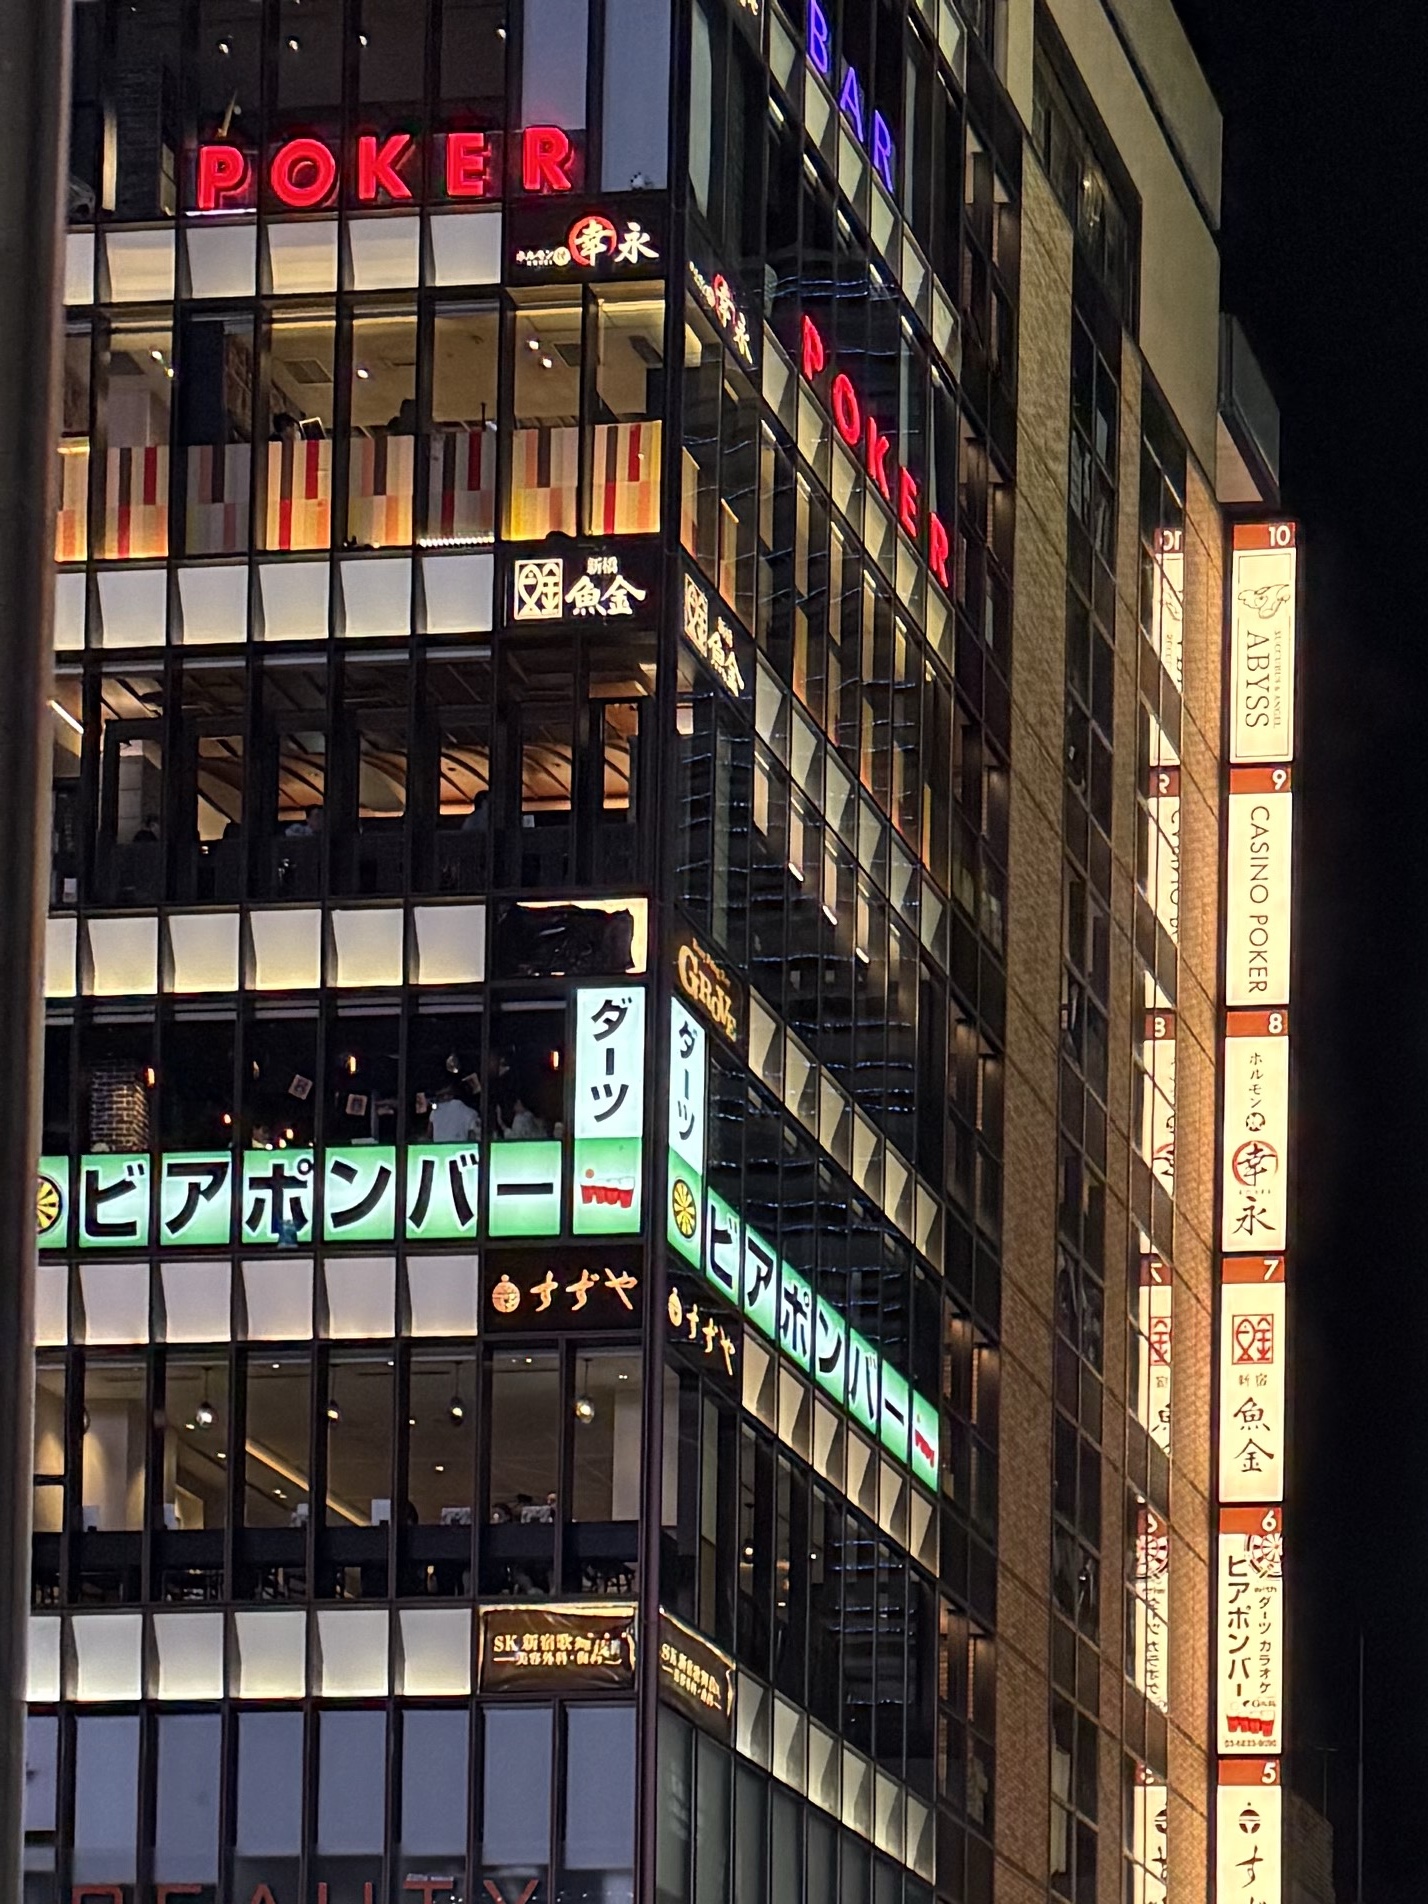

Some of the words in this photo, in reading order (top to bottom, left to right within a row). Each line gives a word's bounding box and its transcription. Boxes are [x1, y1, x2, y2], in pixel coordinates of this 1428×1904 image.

[198, 126, 573, 209] POKER
[568, 217, 660, 266] 幸永
[803, 314, 950, 588] POKER
[1268, 524, 1291, 547] 10
[564, 574, 647, 616] 魚金
[1245, 629, 1270, 729] ABYSS
[1272, 768, 1287, 791] 9
[1249, 805, 1271, 904] CASINO
[1248, 914, 1269, 994] POKER
[677, 943, 738, 1044] GROVE
[1267, 1013, 1283, 1034] 8
[590, 995, 631, 1125] ダーツ
[677, 1018, 696, 1141] ダーツ
[1247, 1051, 1264, 1110] ホルモン
[81, 1151, 557, 1239] ビアポンバー
[1234, 1142, 1277, 1237] 幸永
[530, 1265, 638, 1312] すずや
[1263, 1259, 1279, 1280] 7
[708, 1218, 906, 1429] ビアポンバー
[1232, 1397, 1275, 1474] 魚金
[1260, 1509, 1277, 1532] 6
[493, 1634, 518, 1652] SK
[1261, 1763, 1277, 1783] 5
